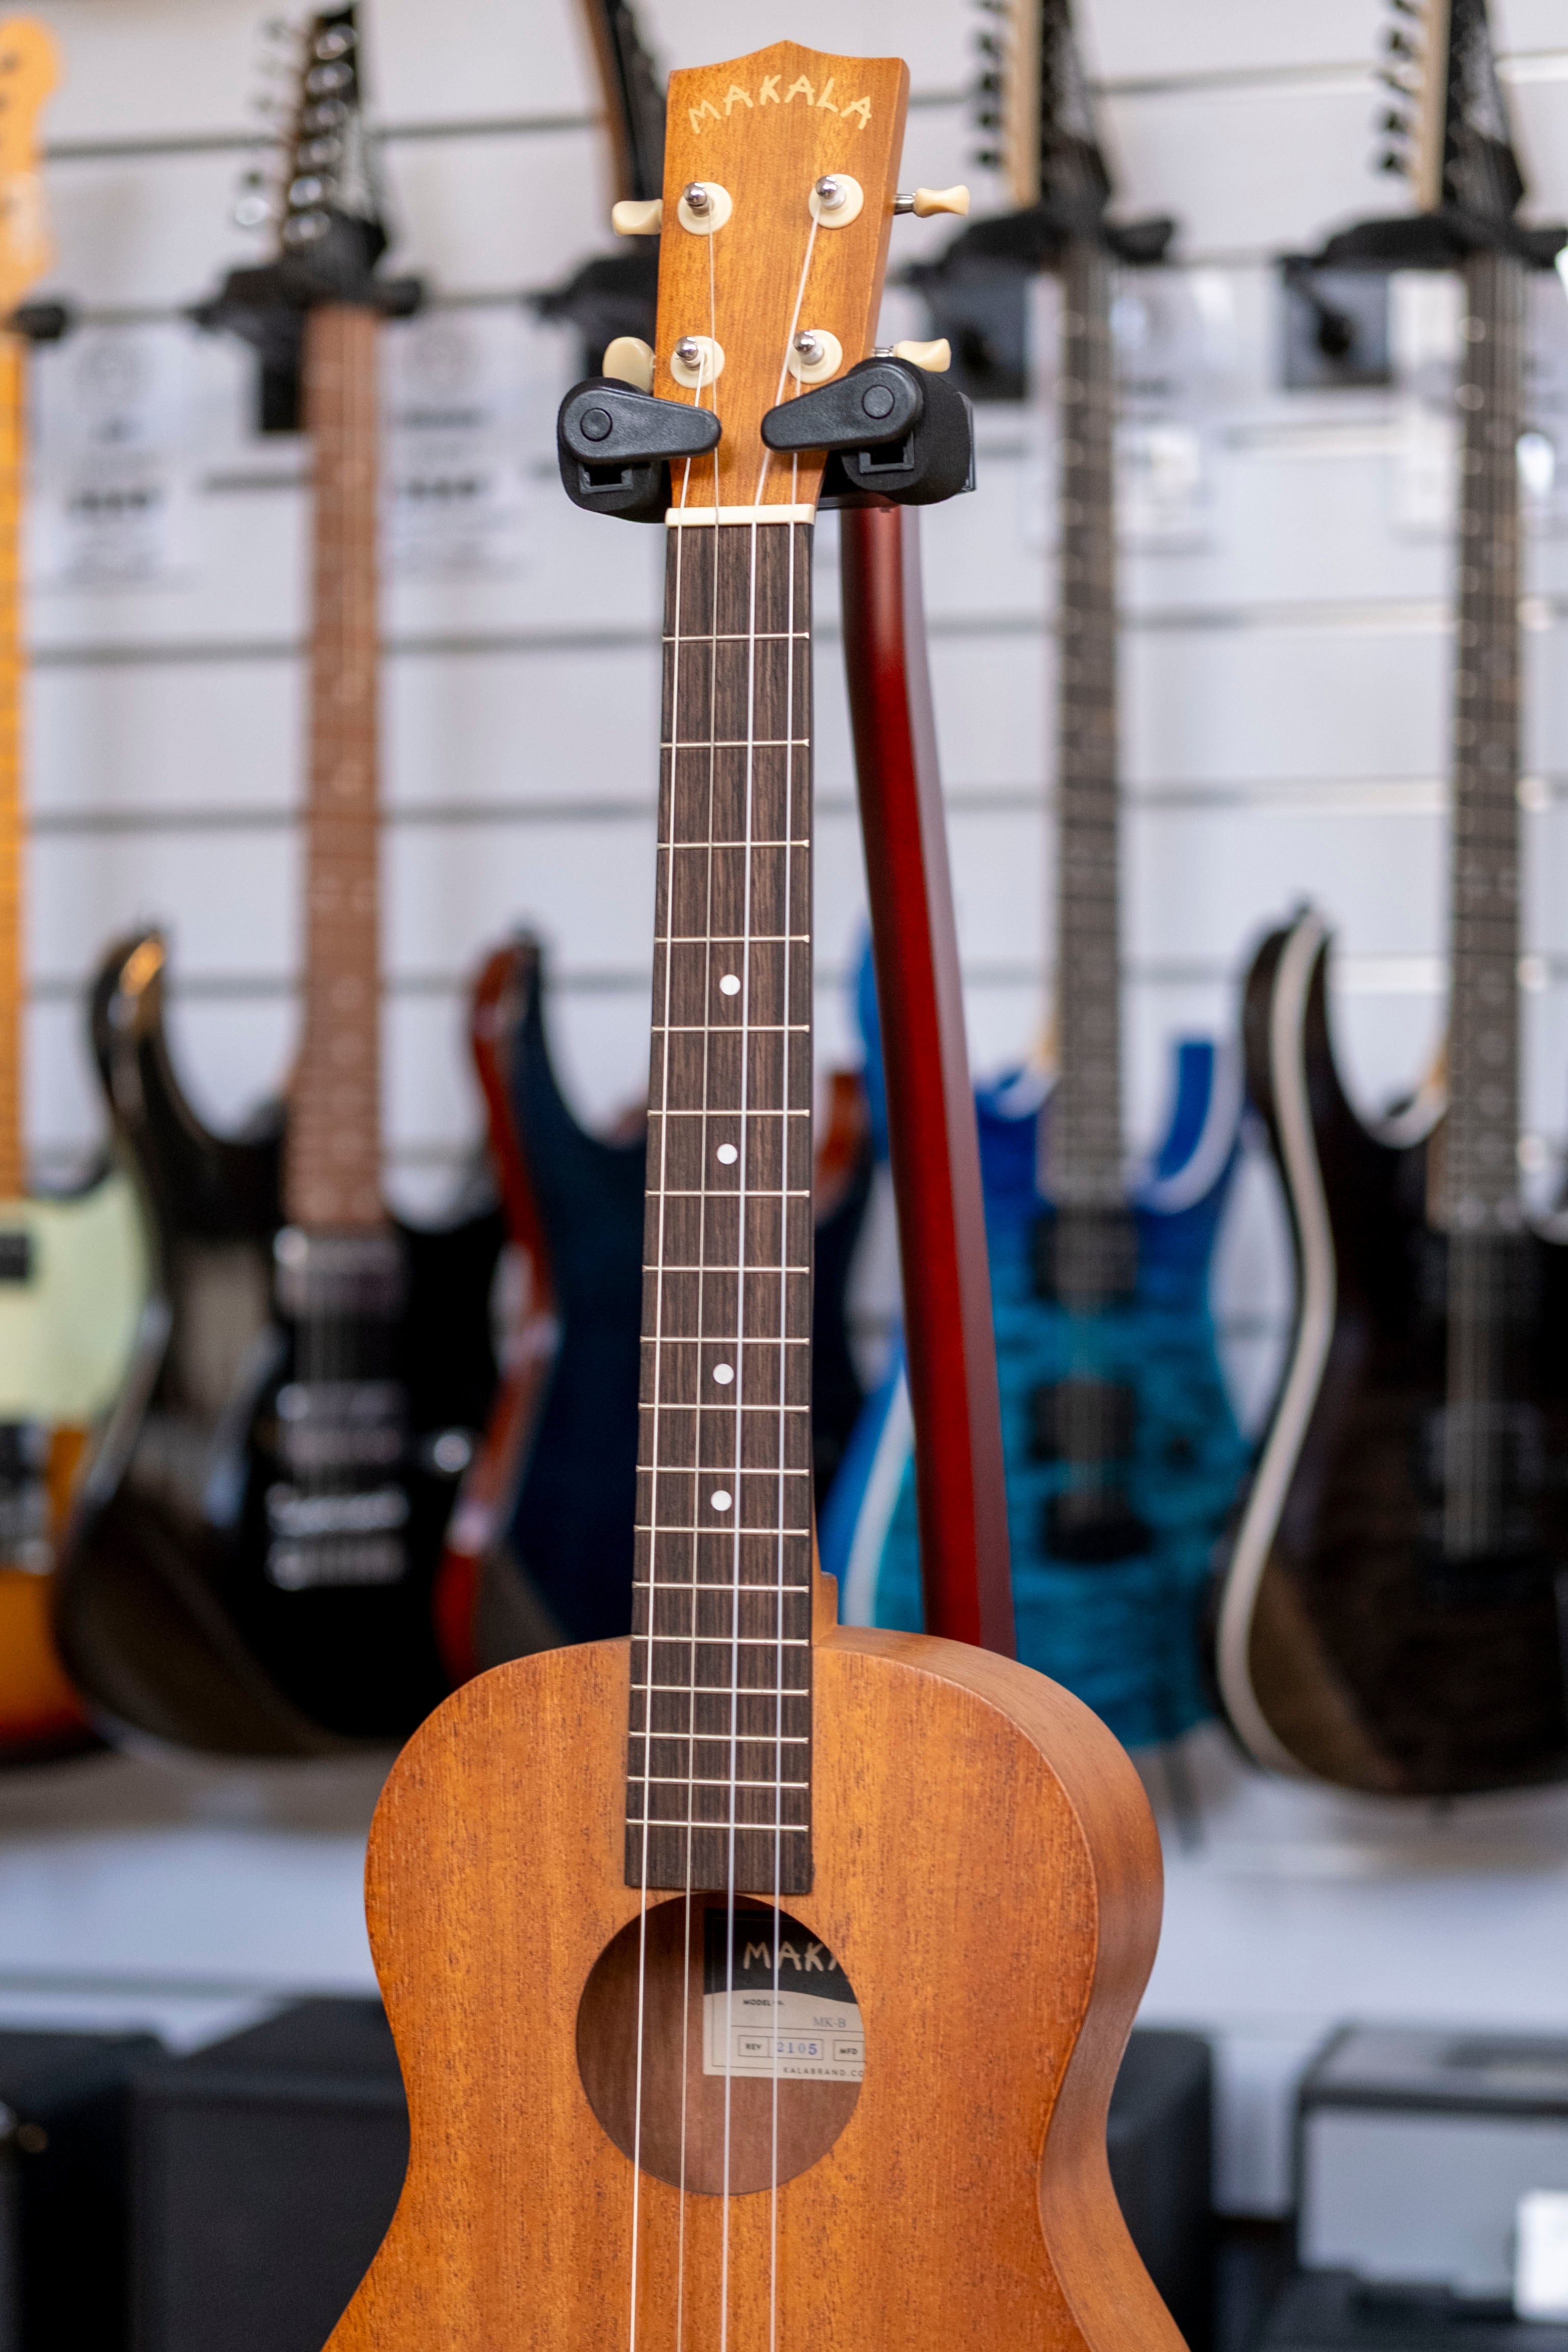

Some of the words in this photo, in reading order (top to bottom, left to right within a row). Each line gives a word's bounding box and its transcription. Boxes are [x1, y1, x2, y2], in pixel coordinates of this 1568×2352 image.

[689, 74, 872, 134] MAKALA
[813, 2016, 846, 2028] MK-B
[777, 2041, 817, 2055] 2105
